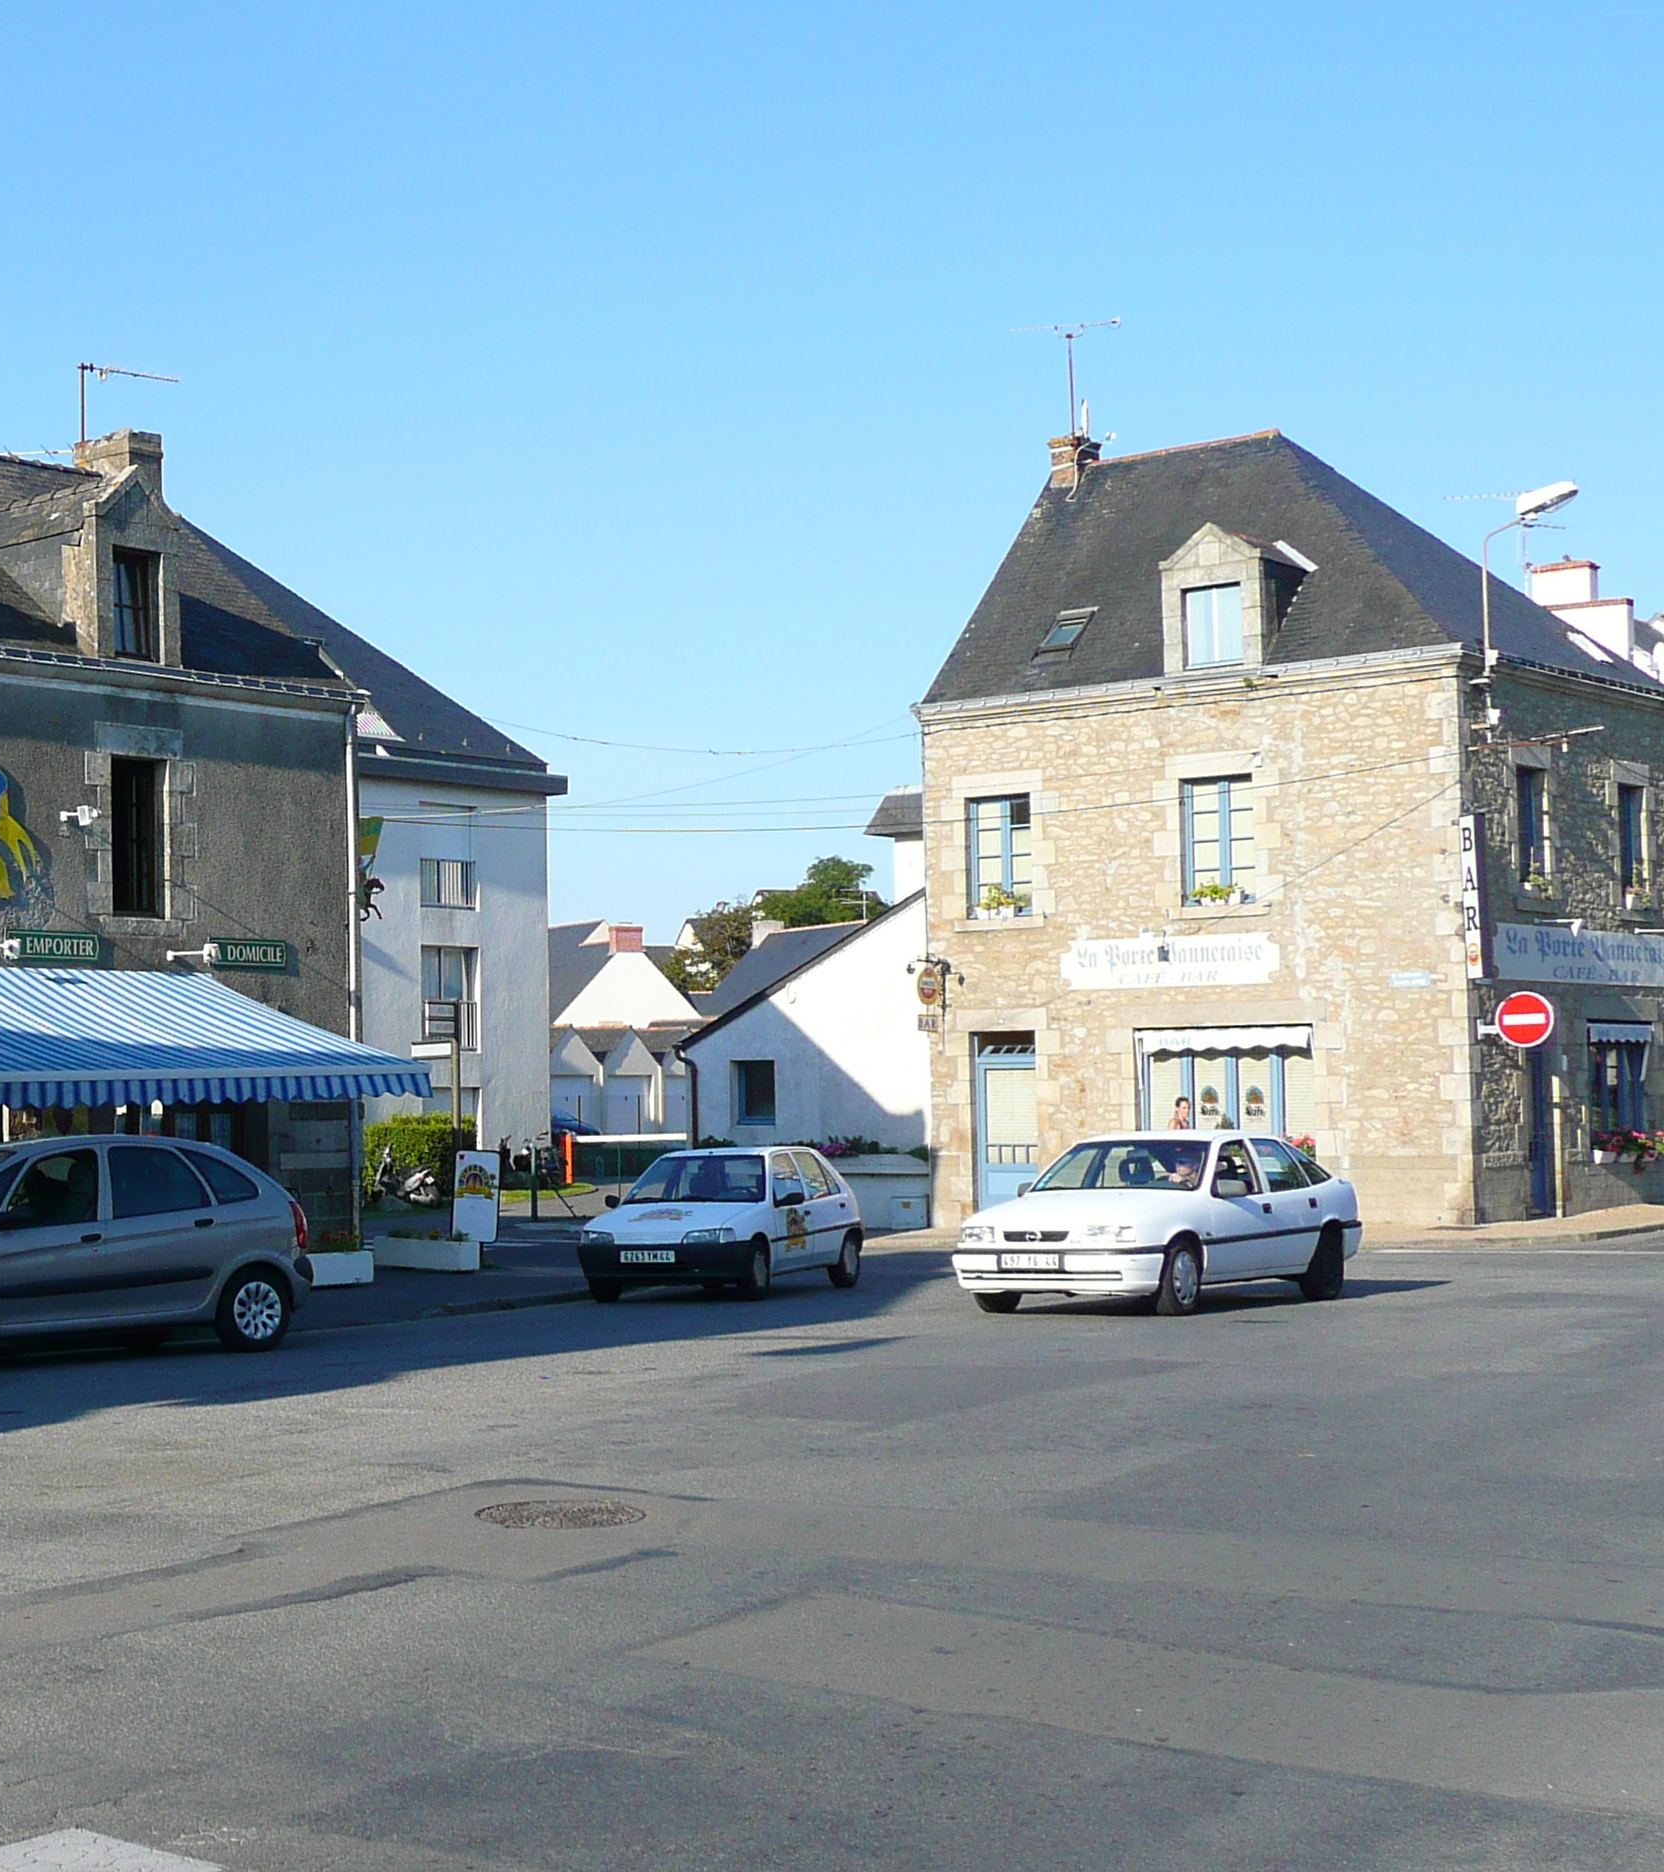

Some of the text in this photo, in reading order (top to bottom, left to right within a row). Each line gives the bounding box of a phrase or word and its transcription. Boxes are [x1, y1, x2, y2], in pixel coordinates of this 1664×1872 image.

[1461, 827, 1481, 931] BAR
[26, 937, 94, 956] EMPORTER
[227, 945, 283, 962] DOMICILE
[1506, 928, 1528, 955] La
[1536, 930, 1585, 962] Porte
[1077, 946, 1098, 968] La
[1105, 944, 1155, 973] Porte
[1119, 970, 1166, 985] CAFÉ
[1180, 970, 1219, 983] BAR
[1553, 965, 1597, 980] CAFÉ
[1609, 969, 1641, 982] BAR
[918, 1017, 937, 1029] BAR
[1159, 1037, 1192, 1046] BAR
